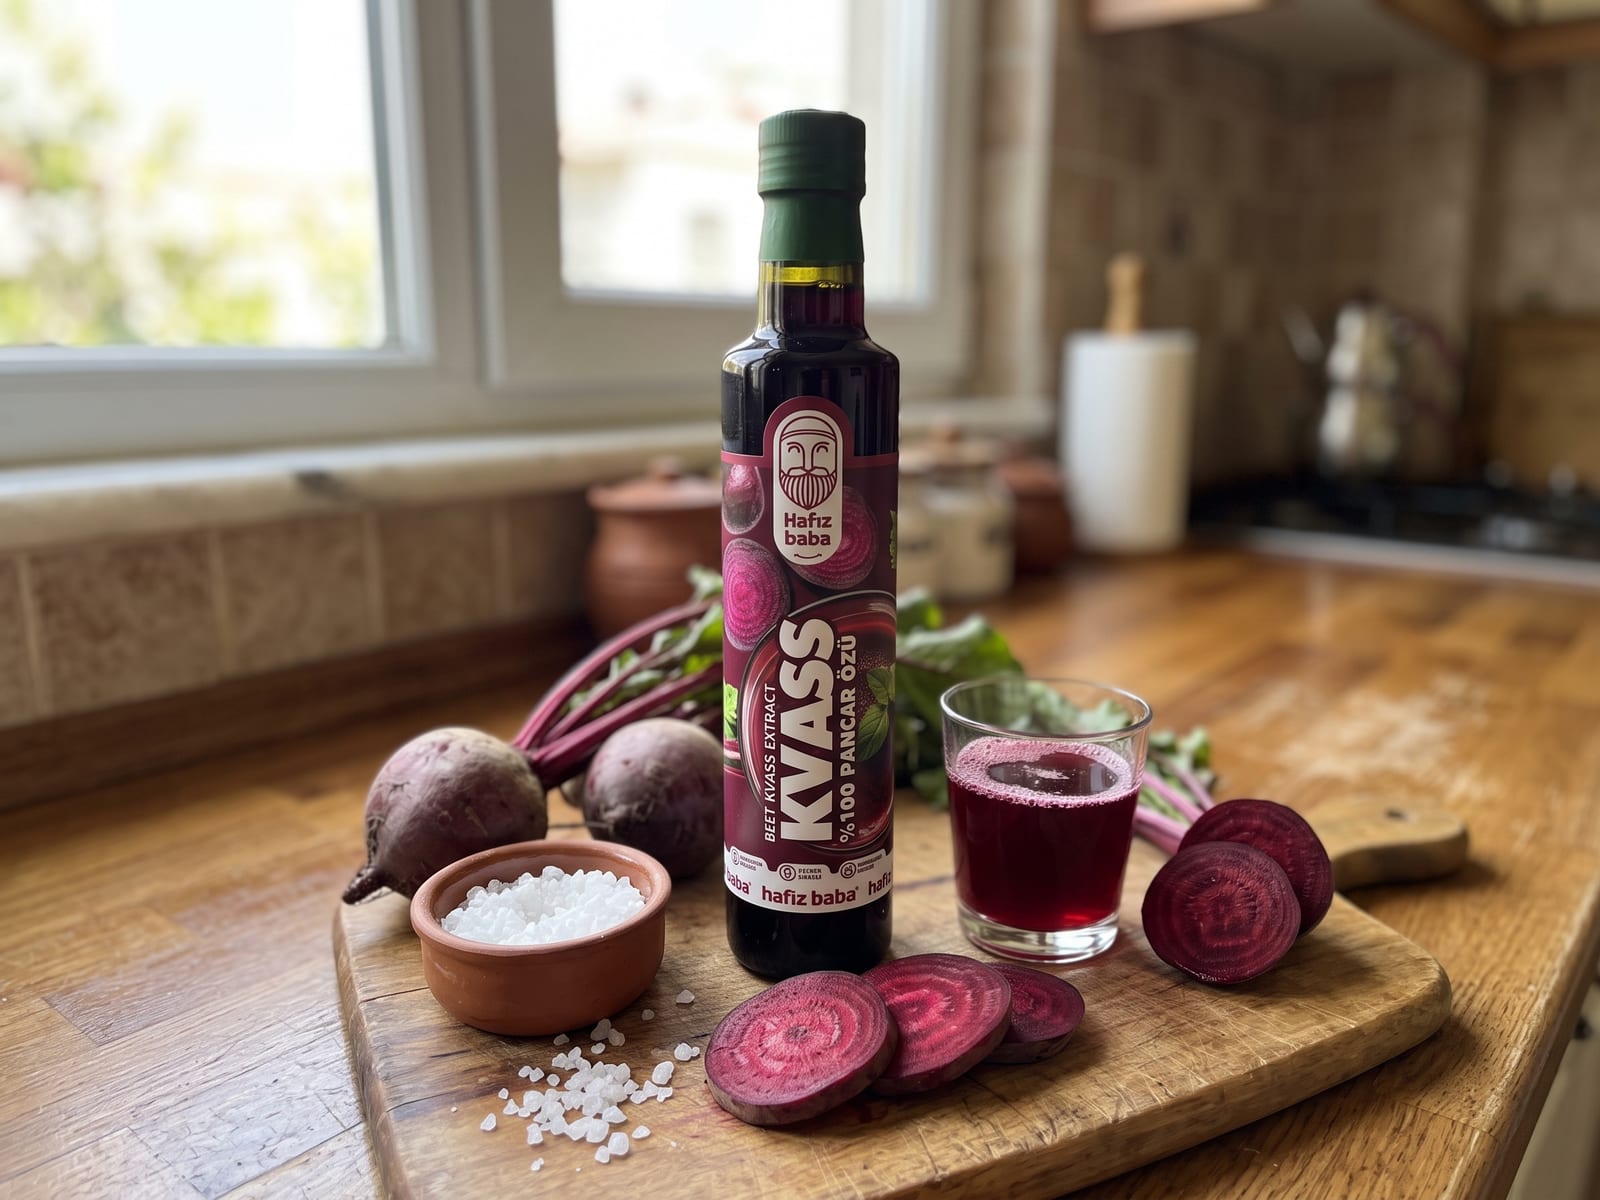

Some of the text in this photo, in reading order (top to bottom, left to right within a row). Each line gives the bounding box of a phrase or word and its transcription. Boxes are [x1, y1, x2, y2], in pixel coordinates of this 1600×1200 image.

[784, 530, 831, 546] baba
[764, 684, 776, 843] BEET KVASS EXTRACT
[779, 618, 835, 841] KVASS
[837, 635, 857, 843] %100 PANCAR ÖZÜ
[727, 866, 750, 895] baba
